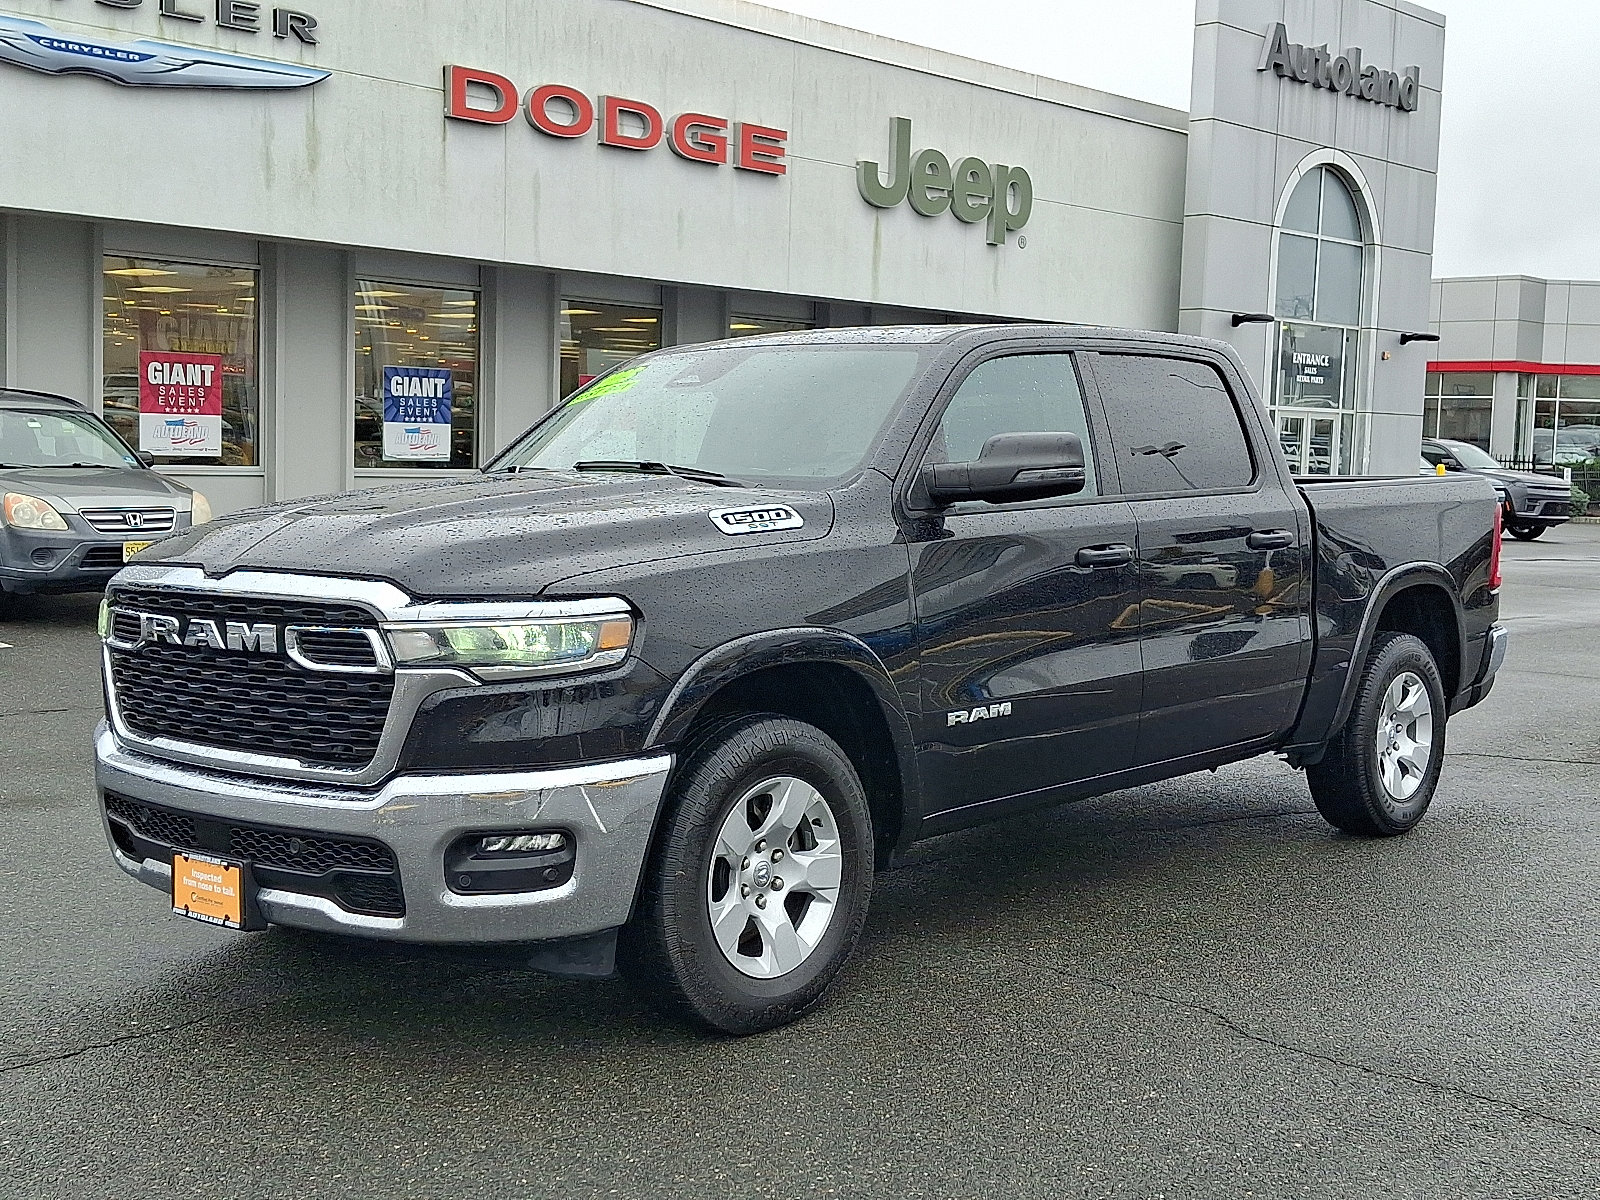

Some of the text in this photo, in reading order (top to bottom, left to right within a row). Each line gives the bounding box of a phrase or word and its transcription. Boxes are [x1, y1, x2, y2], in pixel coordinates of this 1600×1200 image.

[38, 37, 141, 62] CHRYSLER
[1256, 22, 1421, 112] Autoland
[443, 64, 788, 176] DODGE
[856, 116, 1033, 246] Jeep
[1293, 352, 1330, 366] ENTRANCE
[147, 361, 215, 387] GIANT
[158, 385, 205, 397] SALES
[390, 375, 446, 398] GIANT
[158, 396, 206, 407] EVENT
[399, 397, 438, 408] SALES
[399, 406, 438, 417] EVENT
[721, 508, 788, 525] 1500
[141, 612, 278, 654] RAM
[946, 701, 1012, 727] RAM
[183, 876, 236, 897] from nose to tail.
[192, 868, 222, 883] Inspected
